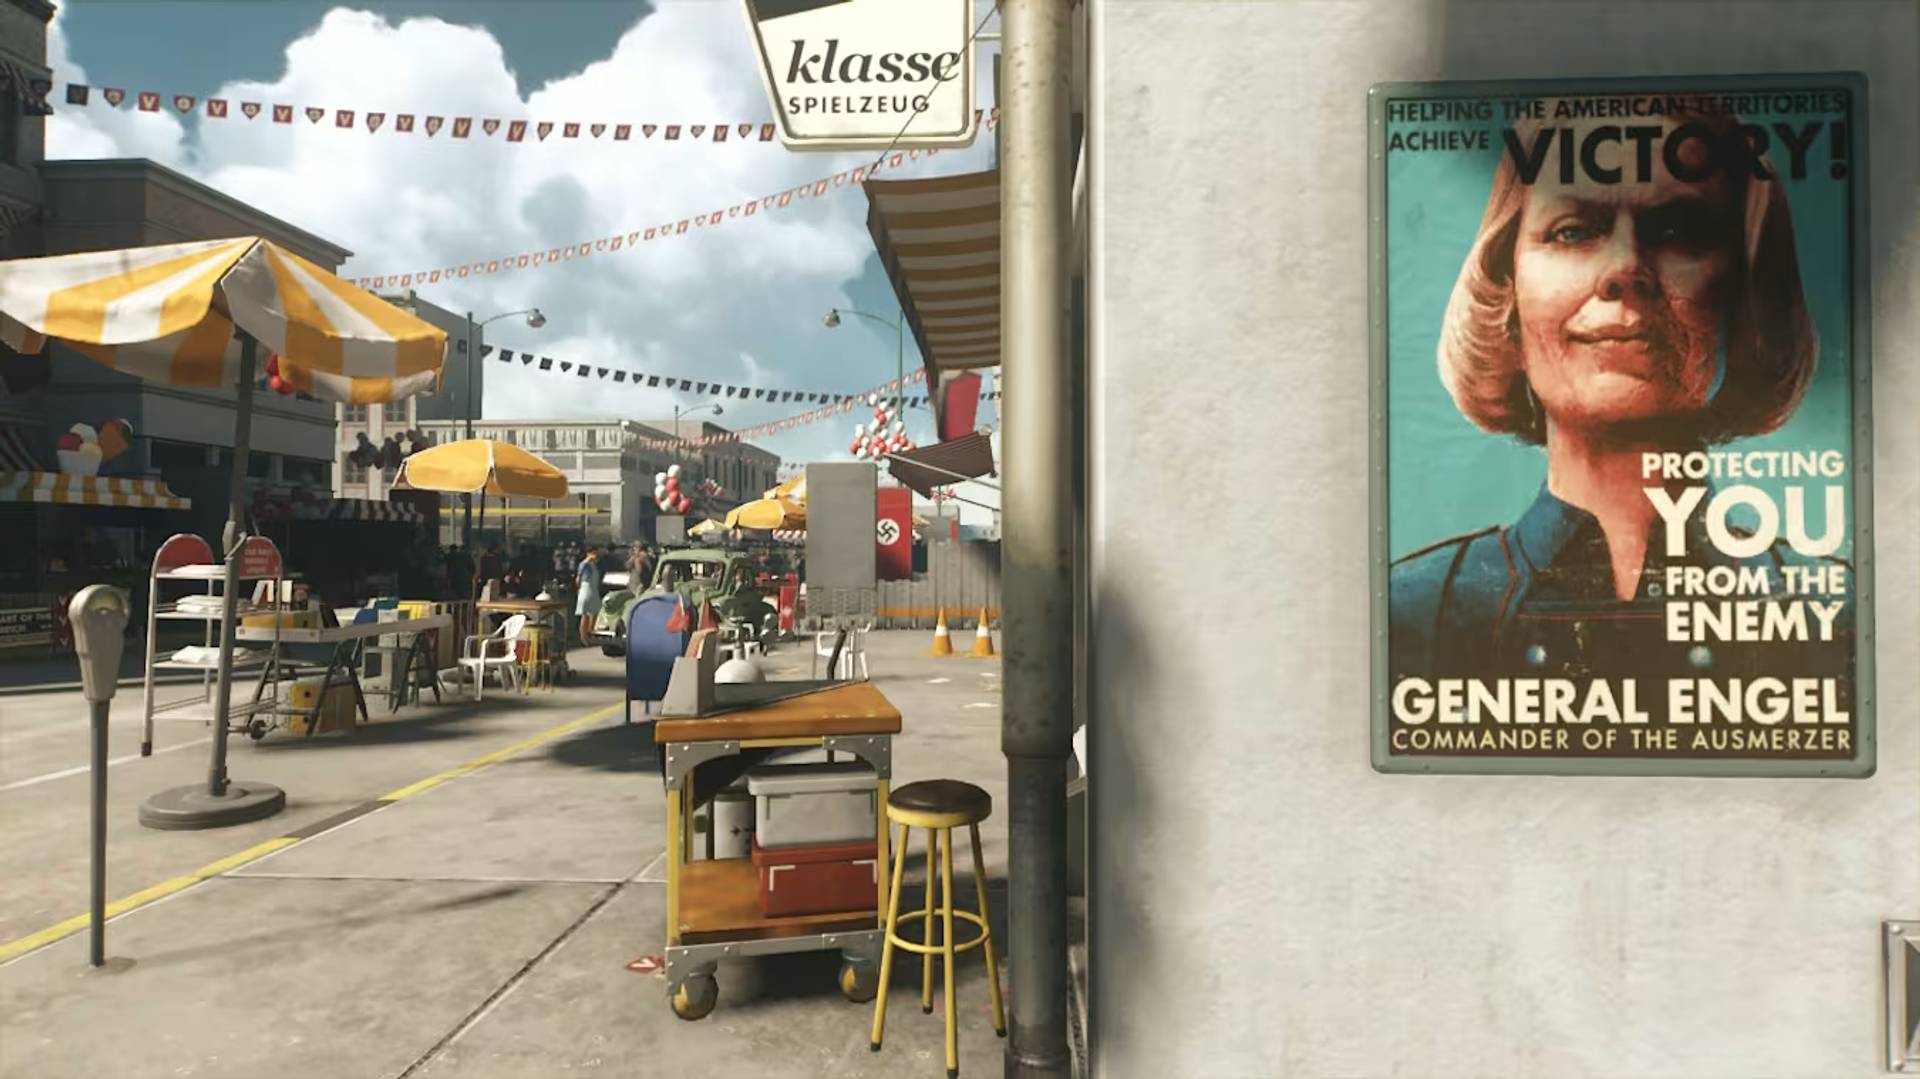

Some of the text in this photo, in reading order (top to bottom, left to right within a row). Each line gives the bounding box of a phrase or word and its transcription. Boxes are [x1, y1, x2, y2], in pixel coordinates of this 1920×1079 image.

[786, 39, 961, 84] klasse
[789, 95, 930, 115] SPIELZEUG
[1388, 93, 1847, 123] HELPING THE AMERICAN TERRITORIES
[1388, 121, 1848, 185] ACHIEVE VICTORY!
[1642, 451, 1845, 479] PROTECTING
[1643, 484, 1846, 558] YOU
[1666, 565, 1846, 596] FROM THE
[1666, 601, 1844, 641] ENEMY
[1392, 677, 1850, 725] GENERAL ENGEL
[1392, 729, 1851, 750] COMMANDER OF THE AUSMERZER
